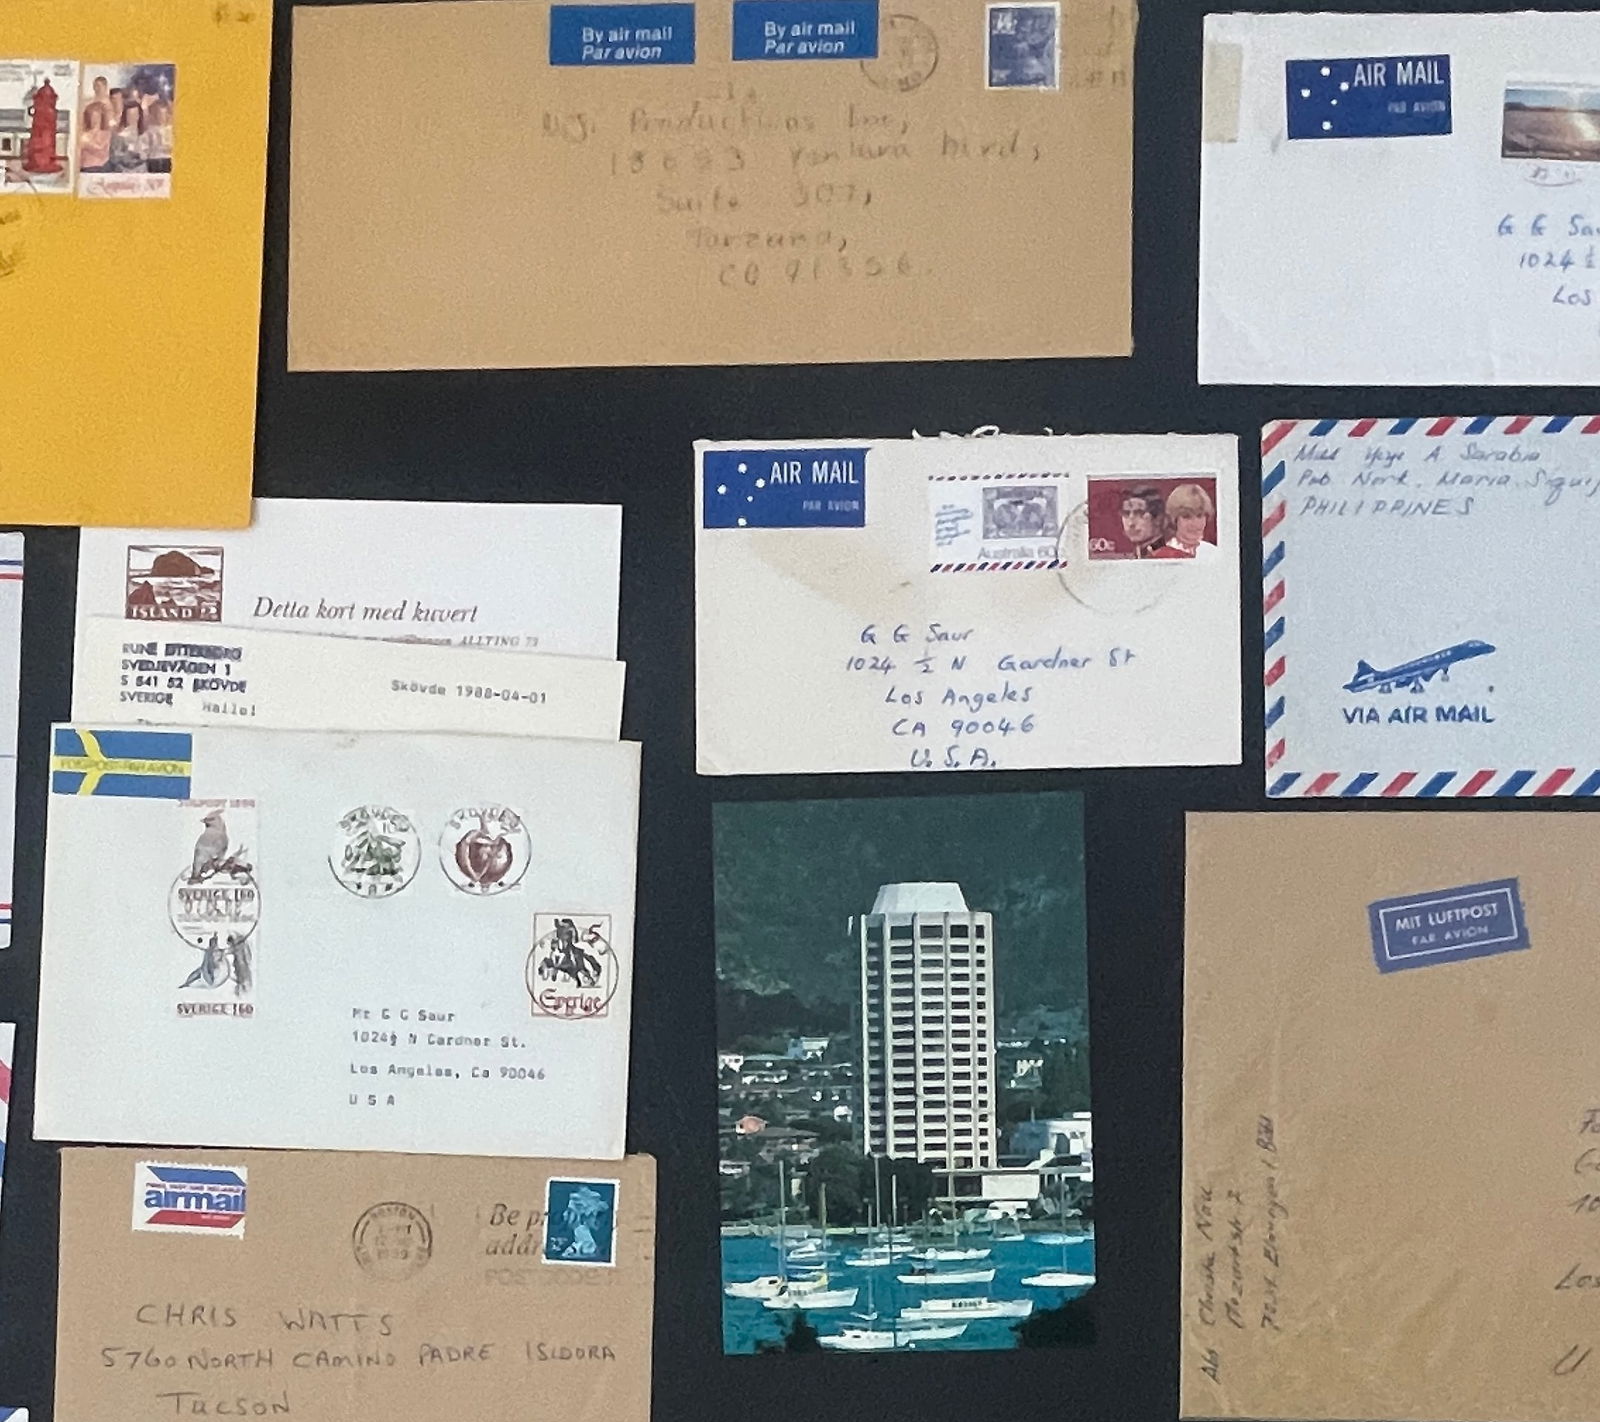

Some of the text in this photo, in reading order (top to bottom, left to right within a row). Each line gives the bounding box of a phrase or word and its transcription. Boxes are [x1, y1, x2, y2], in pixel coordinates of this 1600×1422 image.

[582, 26, 672, 44] By air mail
[764, 20, 855, 39] By air mail
[582, 45, 662, 60] Par avion
[764, 39, 845, 55] Par avion
[1353, 61, 1445, 87] AIR MAIL
[1519, 250, 1575, 271] 1024
[1552, 286, 1592, 306] Los
[769, 460, 859, 484] AIR MAIL
[802, 500, 859, 512] PAR AVION
[1300, 496, 1475, 517] PHILIPPINES
[253, 595, 480, 624] Detta kort med kuvert
[860, 623, 975, 645] G G Saur
[121, 642, 158, 656] RUNE
[846, 647, 1136, 676] 1024 N Gardner St
[120, 674, 129, 686] S
[135, 675, 159, 688] 541
[166, 677, 184, 690] 52
[391, 679, 547, 704] Skövde 1988-04-01
[119, 690, 174, 706] SVERIGE
[885, 681, 1034, 713] Los Angeles
[1342, 704, 1496, 725] VIA AIR MAIL
[892, 713, 1035, 739] CA 90046
[178, 887, 231, 901] SVERIGE
[1395, 902, 1499, 932] MIT LUFTPOST
[1444, 925, 1489, 942] AVION
[177, 1002, 230, 1017] SVERIGE
[352, 1007, 456, 1023] Mr Saur
[408, 1034, 526, 1049] N St.
[350, 1063, 546, 1080] Los Angeles, Ca 90046
[144, 1188, 247, 1212] airmail
[490, 1203, 520, 1226] Be
[136, 1302, 393, 1336] CHRIS WATTS
[100, 1341, 617, 1371] 5760 NORTH CAMINO PADRE ISIDORA
